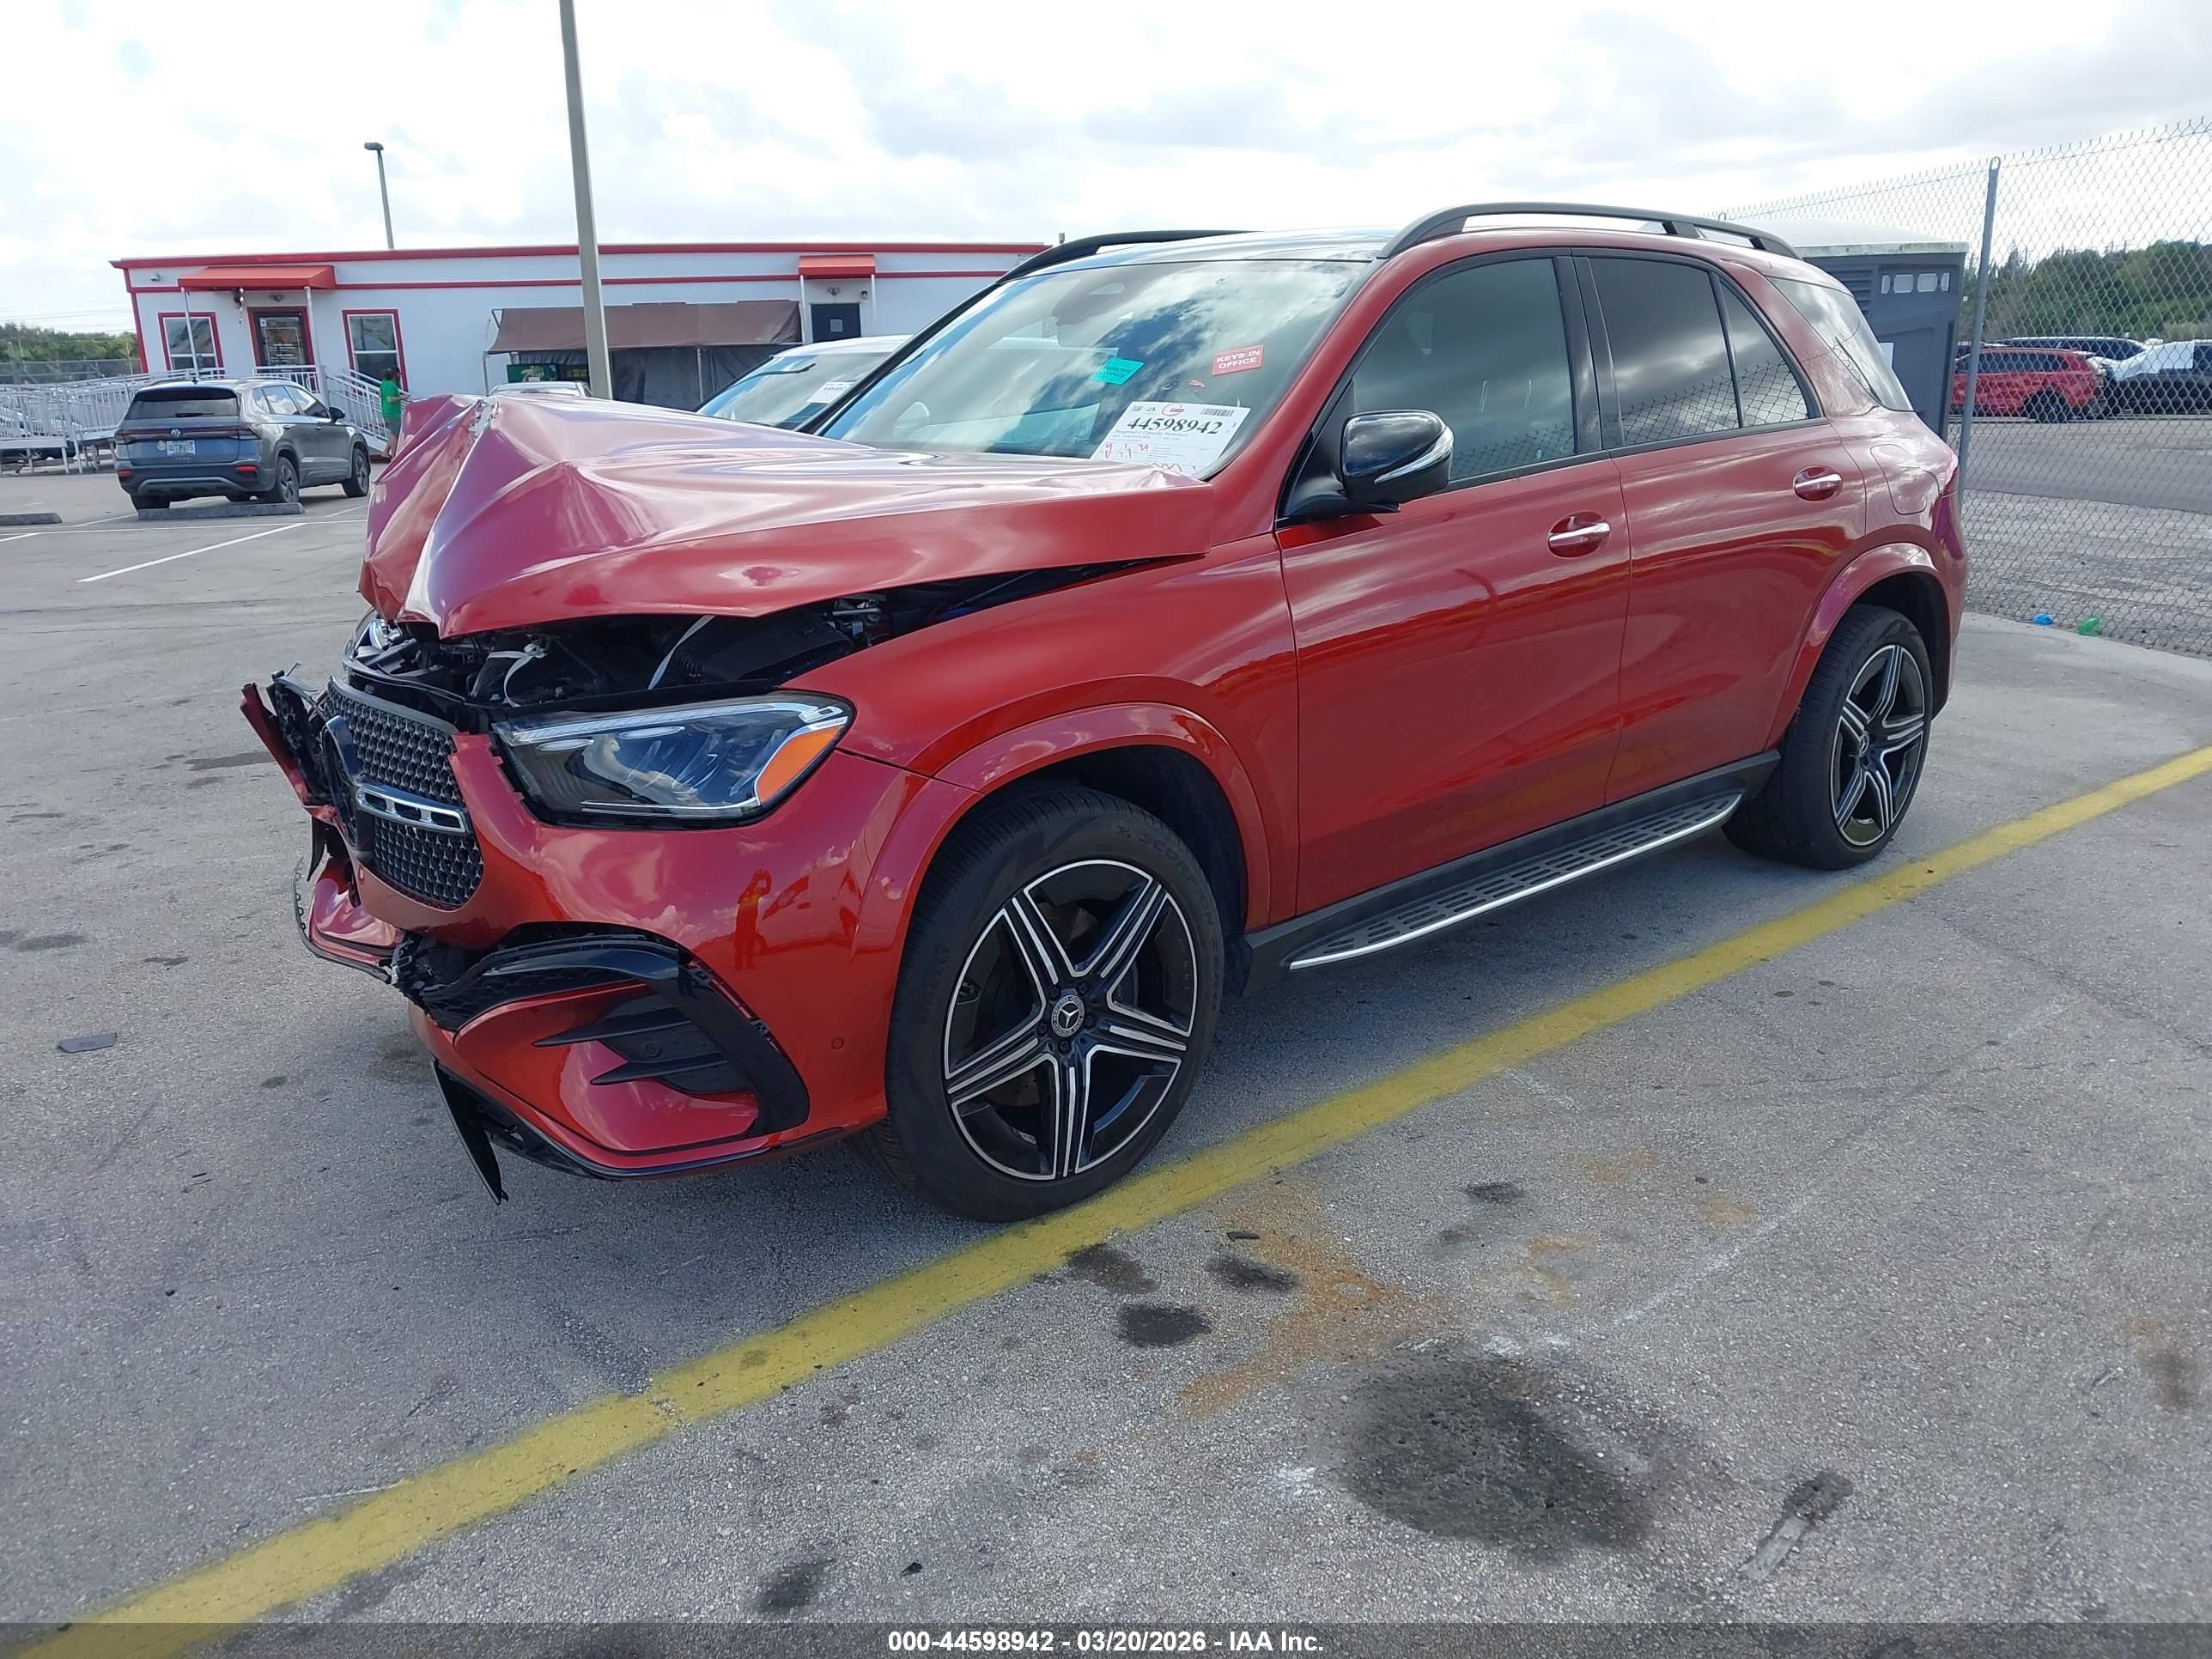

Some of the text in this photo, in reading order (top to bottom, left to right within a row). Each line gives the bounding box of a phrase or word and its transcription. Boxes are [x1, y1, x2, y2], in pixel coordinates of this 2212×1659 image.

[1217, 352, 1245, 363] KEYS
[1218, 356, 1256, 369] OFFICE
[1127, 416, 1223, 434] 44598942
